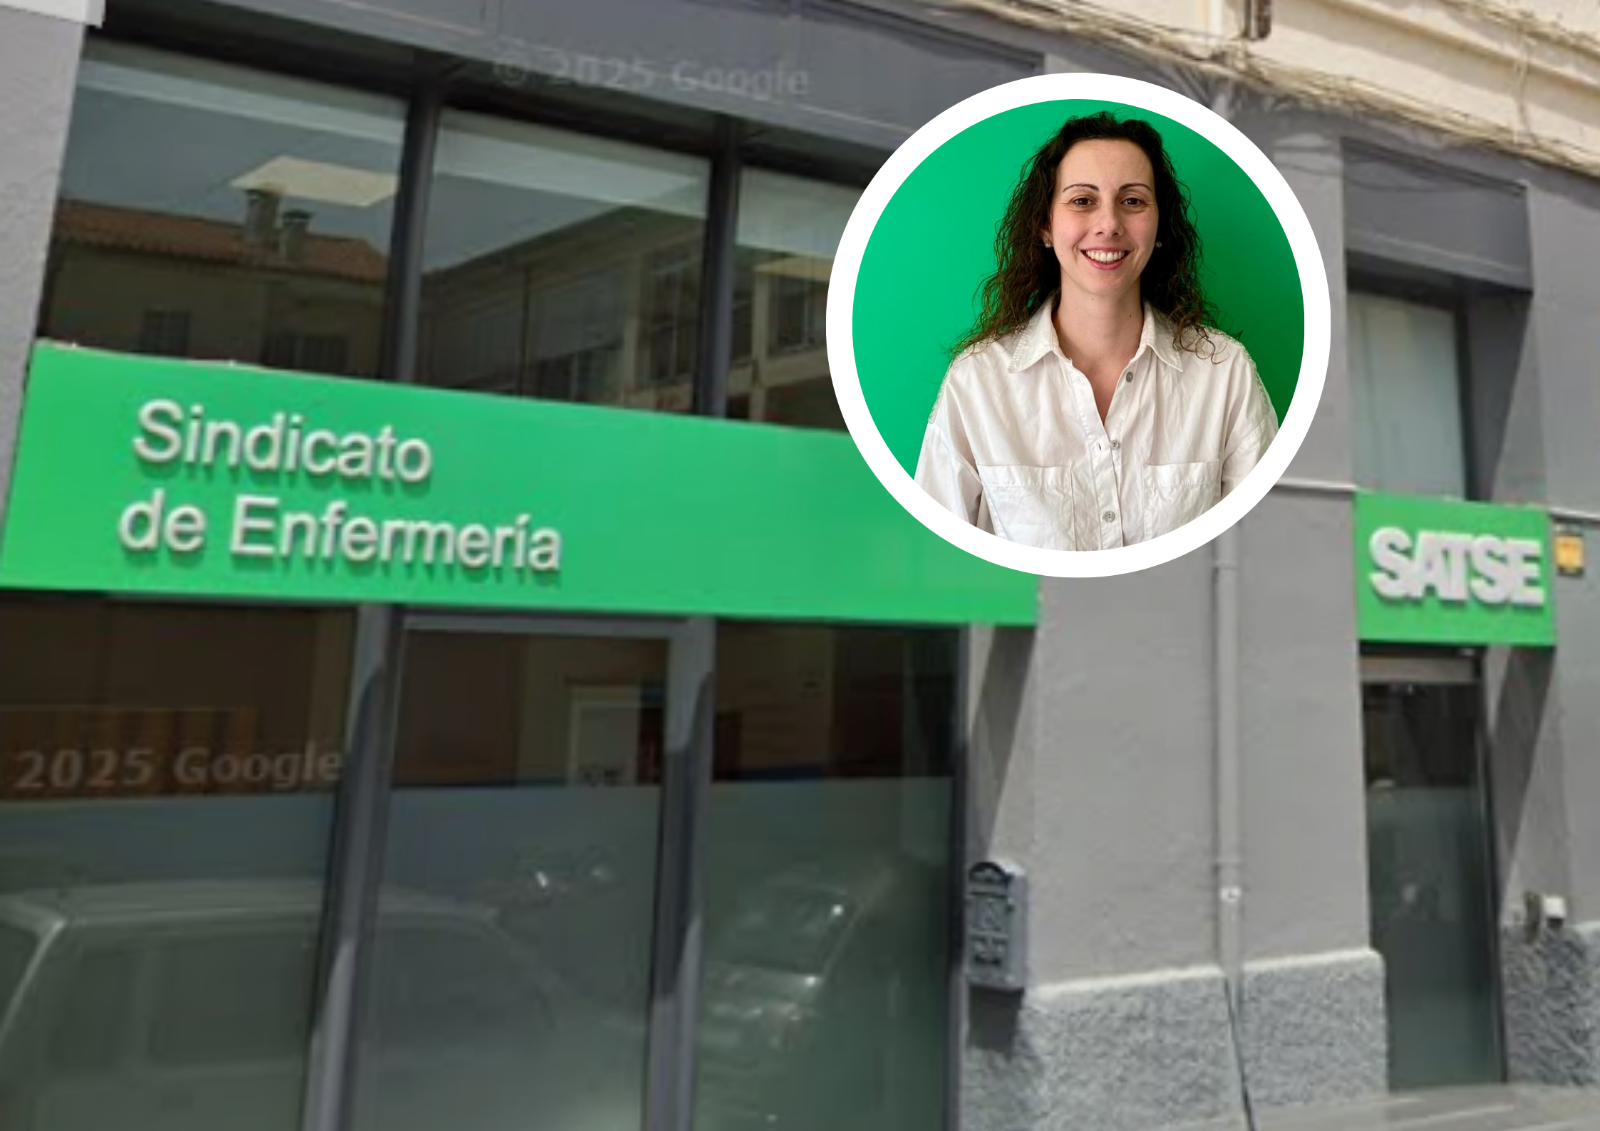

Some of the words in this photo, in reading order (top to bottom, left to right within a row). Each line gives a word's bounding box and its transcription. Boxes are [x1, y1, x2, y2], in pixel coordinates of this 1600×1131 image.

[132, 399, 432, 482] Sindicato
[119, 488, 206, 552] de
[230, 494, 562, 571] Enfermería
[1368, 526, 1544, 607] SATSE
